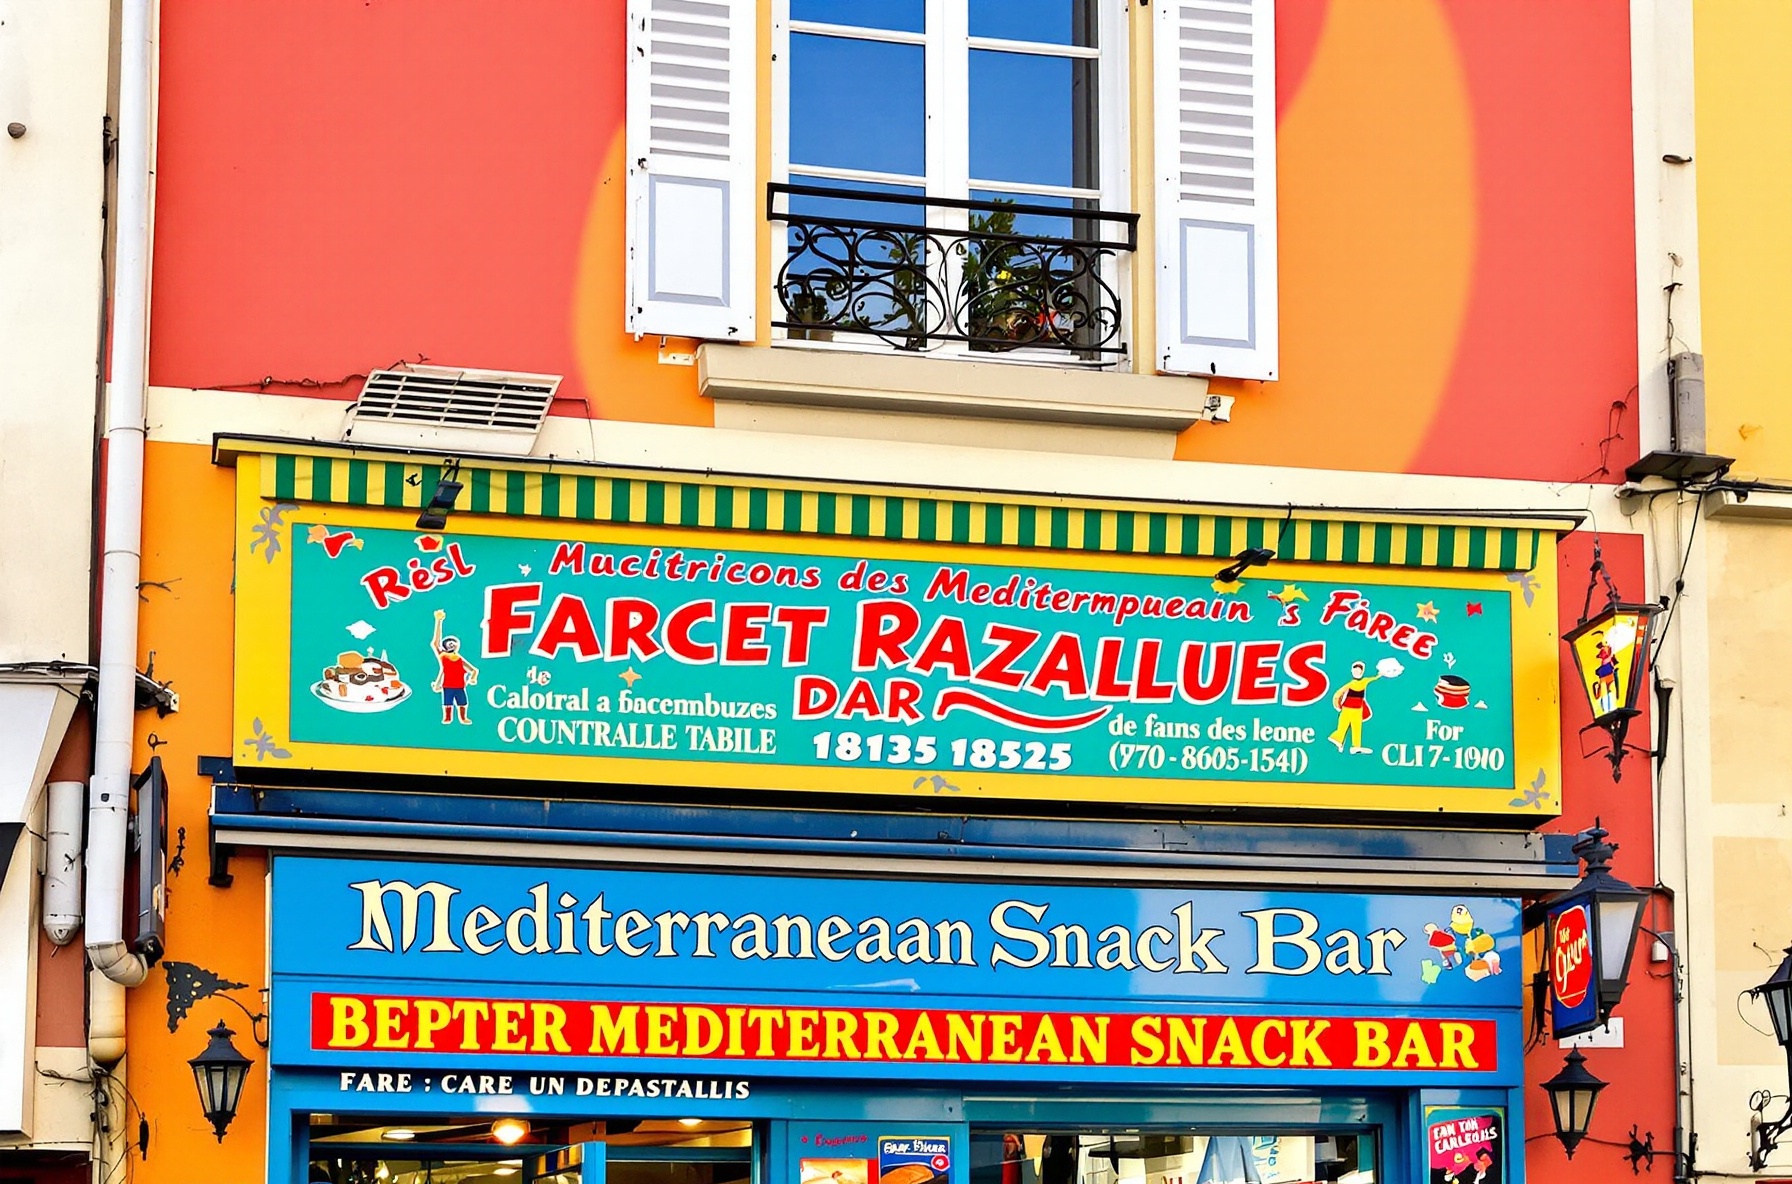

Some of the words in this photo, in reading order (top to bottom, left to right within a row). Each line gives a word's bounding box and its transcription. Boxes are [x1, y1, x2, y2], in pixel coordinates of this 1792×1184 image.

[550, 542, 821, 588] Mucitricons
[838, 560, 909, 594] des
[480, 582, 830, 667] FARCET
[852, 598, 1330, 708] RAZALLUES
[487, 685, 589, 711] Calotral
[597, 695, 611, 713] a
[792, 674, 925, 726] DAR
[497, 716, 677, 750] COUNTRALLE
[685, 724, 777, 755] TABILE
[1108, 713, 1137, 736] de
[1207, 717, 1247, 741] des
[1425, 719, 1464, 741] For
[813, 731, 938, 766] 18135
[950, 737, 1073, 772] 18525
[347, 879, 978, 967] Mediterraneaan
[989, 898, 1229, 974] Snack
[1238, 907, 1406, 976] Bar
[327, 997, 571, 1054] BEPTER
[588, 1004, 1110, 1065] MEDITERRANEAN
[1130, 1015, 1332, 1068] SNACK
[1352, 1020, 1479, 1070] BAR
[339, 1073, 412, 1093] FARE
[440, 1075, 513, 1095] CARE
[529, 1077, 564, 1096] UN
[575, 1077, 750, 1100] DEPASTALLIS
